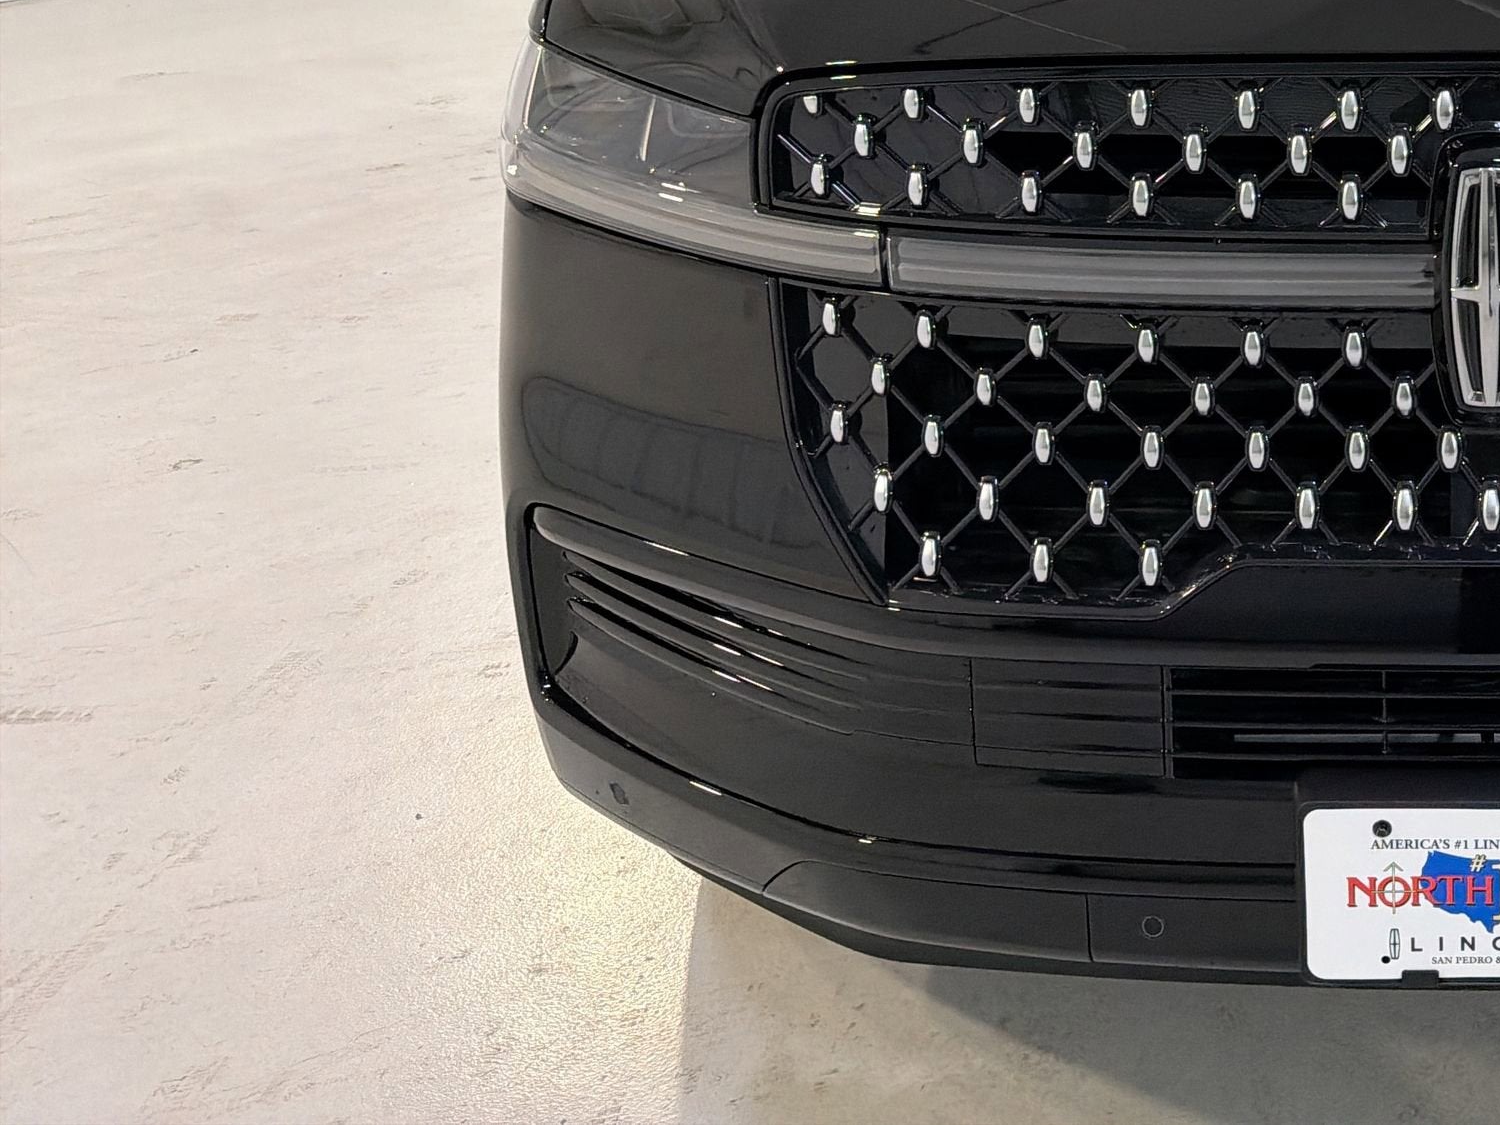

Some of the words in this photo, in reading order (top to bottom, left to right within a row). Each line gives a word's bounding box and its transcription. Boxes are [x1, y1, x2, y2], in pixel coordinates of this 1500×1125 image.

[1371, 838, 1450, 850] AMERICA'S
[1454, 839, 1469, 850] #1
[1346, 874, 1494, 908] NORTH
[1431, 955, 1453, 965] SAN
[1456, 956, 1493, 964] PEDRO
